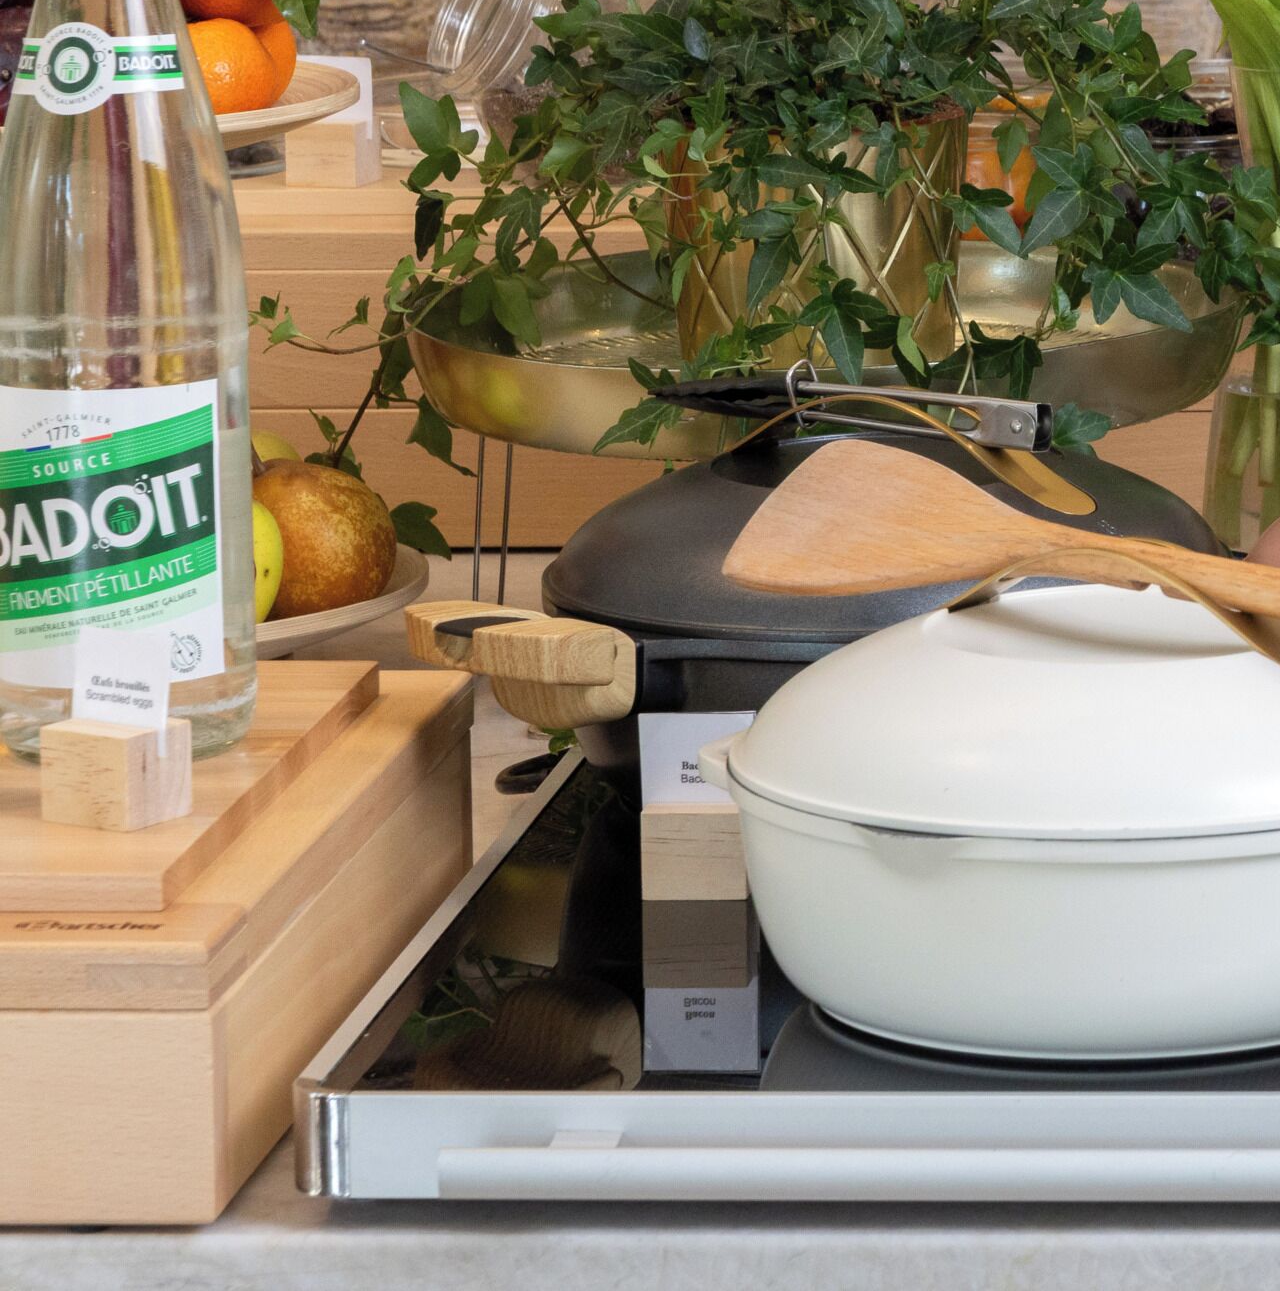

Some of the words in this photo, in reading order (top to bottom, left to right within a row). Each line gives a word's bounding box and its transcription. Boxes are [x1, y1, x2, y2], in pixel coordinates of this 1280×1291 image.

[119, 53, 177, 72] BADOIT
[22, 413, 112, 439] SAINT-GALMIER
[46, 425, 80, 441] 1778
[32, 452, 113, 478] SOURCE
[84, 554, 196, 600] PÉTILLANTE
[69, 611, 117, 626] NATURELLE
[134, 600, 159, 614] SAINT
[681, 761, 699, 771] Bac
